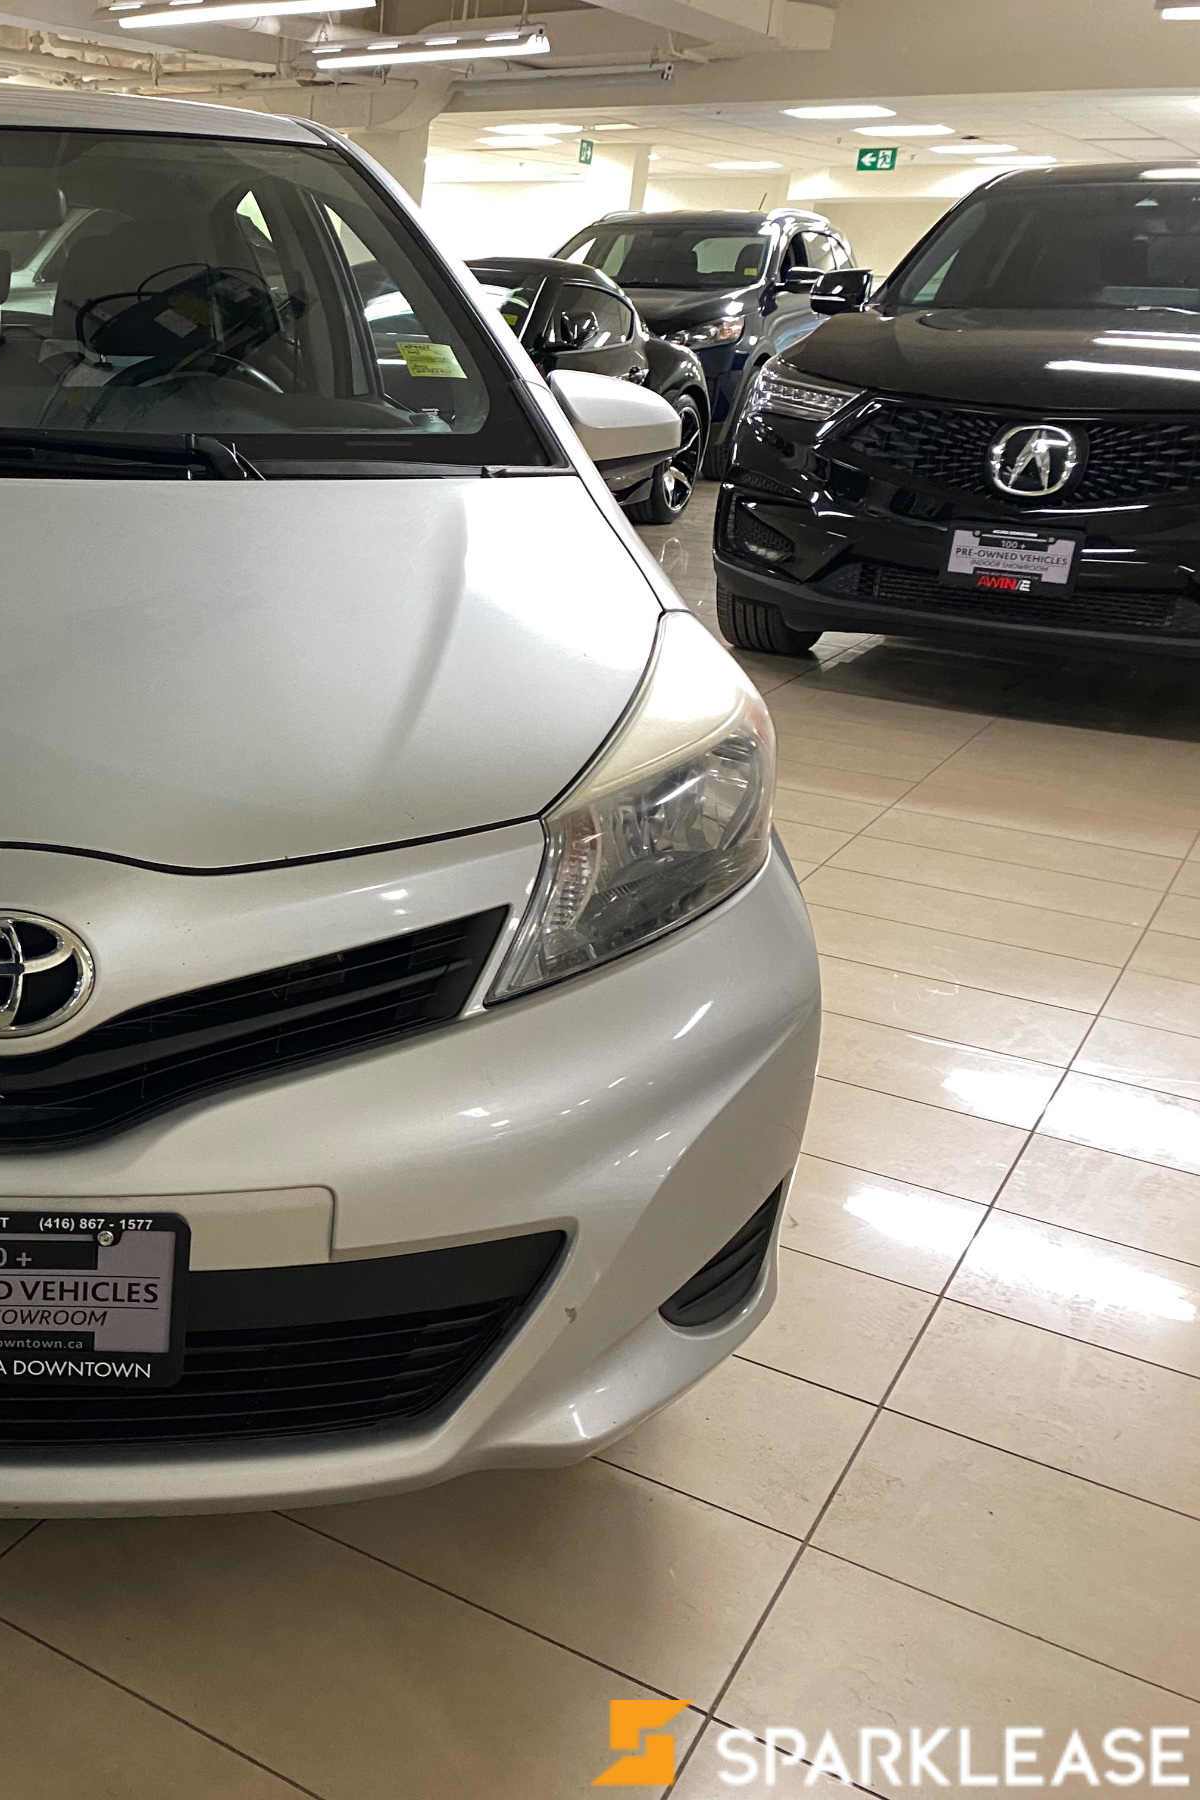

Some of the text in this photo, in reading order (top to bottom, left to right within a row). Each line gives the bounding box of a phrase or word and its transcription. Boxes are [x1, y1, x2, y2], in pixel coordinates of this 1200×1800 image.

[1001, 539, 1018, 549] 100
[955, 547, 1068, 566] PRE-OWNED VEHICLES
[39, 1218, 75, 1231] (416)
[79, 1219, 105, 1229] 867
[119, 1220, 152, 1230] 1577
[16, 1252, 32, 1267] +
[20, 1280, 159, 1303] VEHICLES
[13, 1359, 151, 1378] DOWNTOWN
